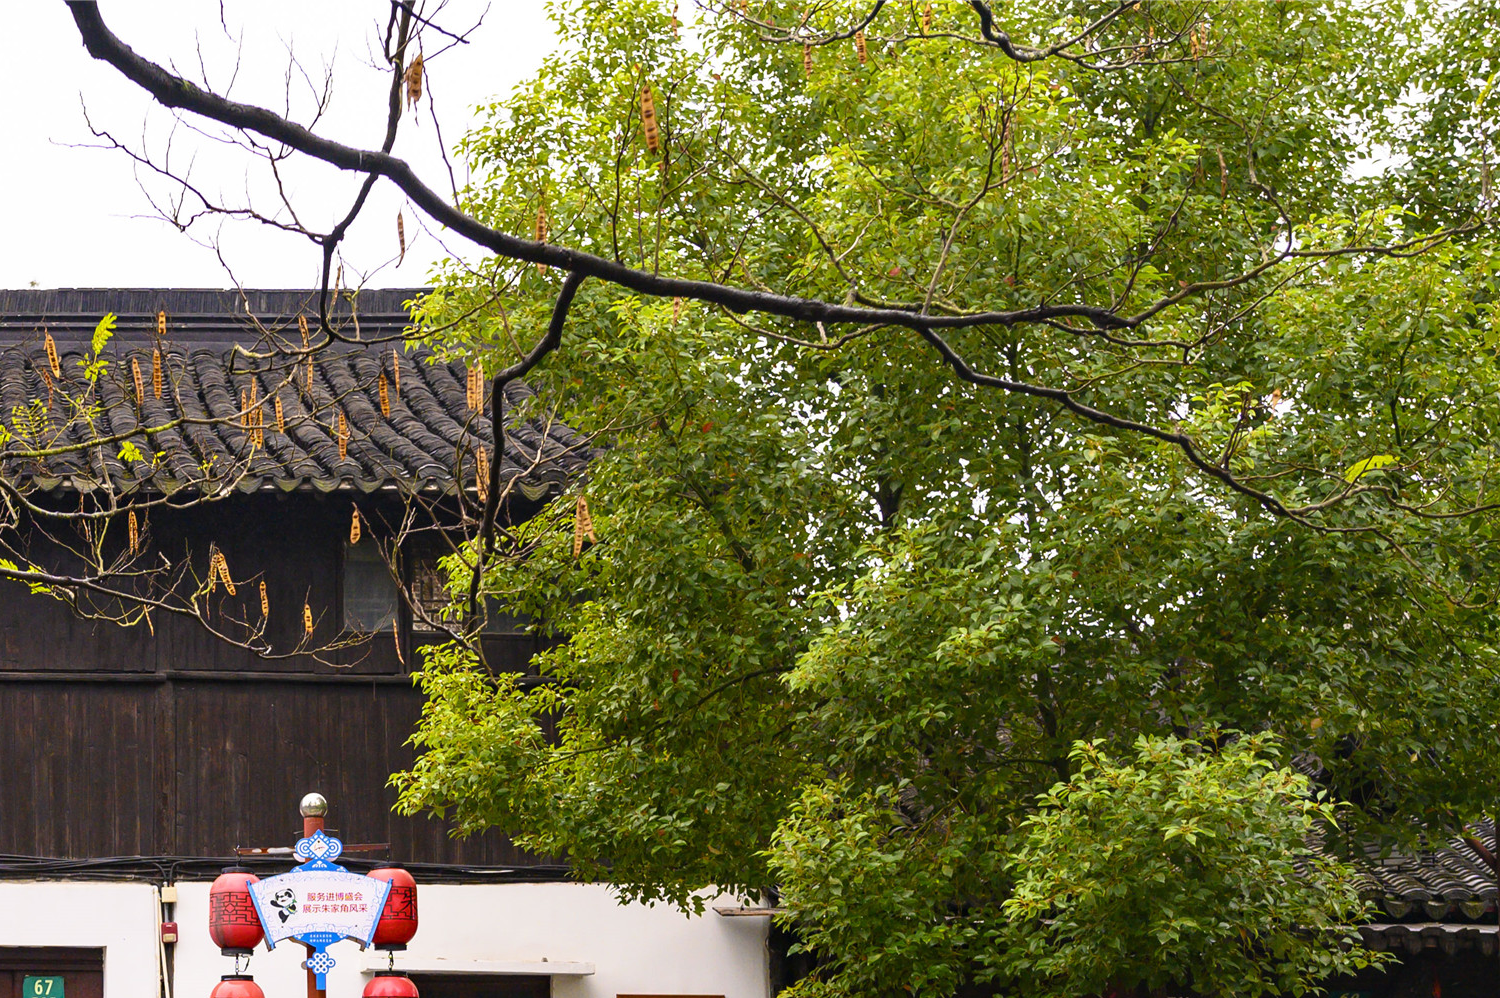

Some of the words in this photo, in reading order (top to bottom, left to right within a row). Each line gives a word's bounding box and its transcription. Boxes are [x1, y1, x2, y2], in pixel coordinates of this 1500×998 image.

[306, 891, 364, 902] 服务进博盛会
[302, 903, 369, 914] 展示朱家角风采
[34, 979, 54, 995] 67
